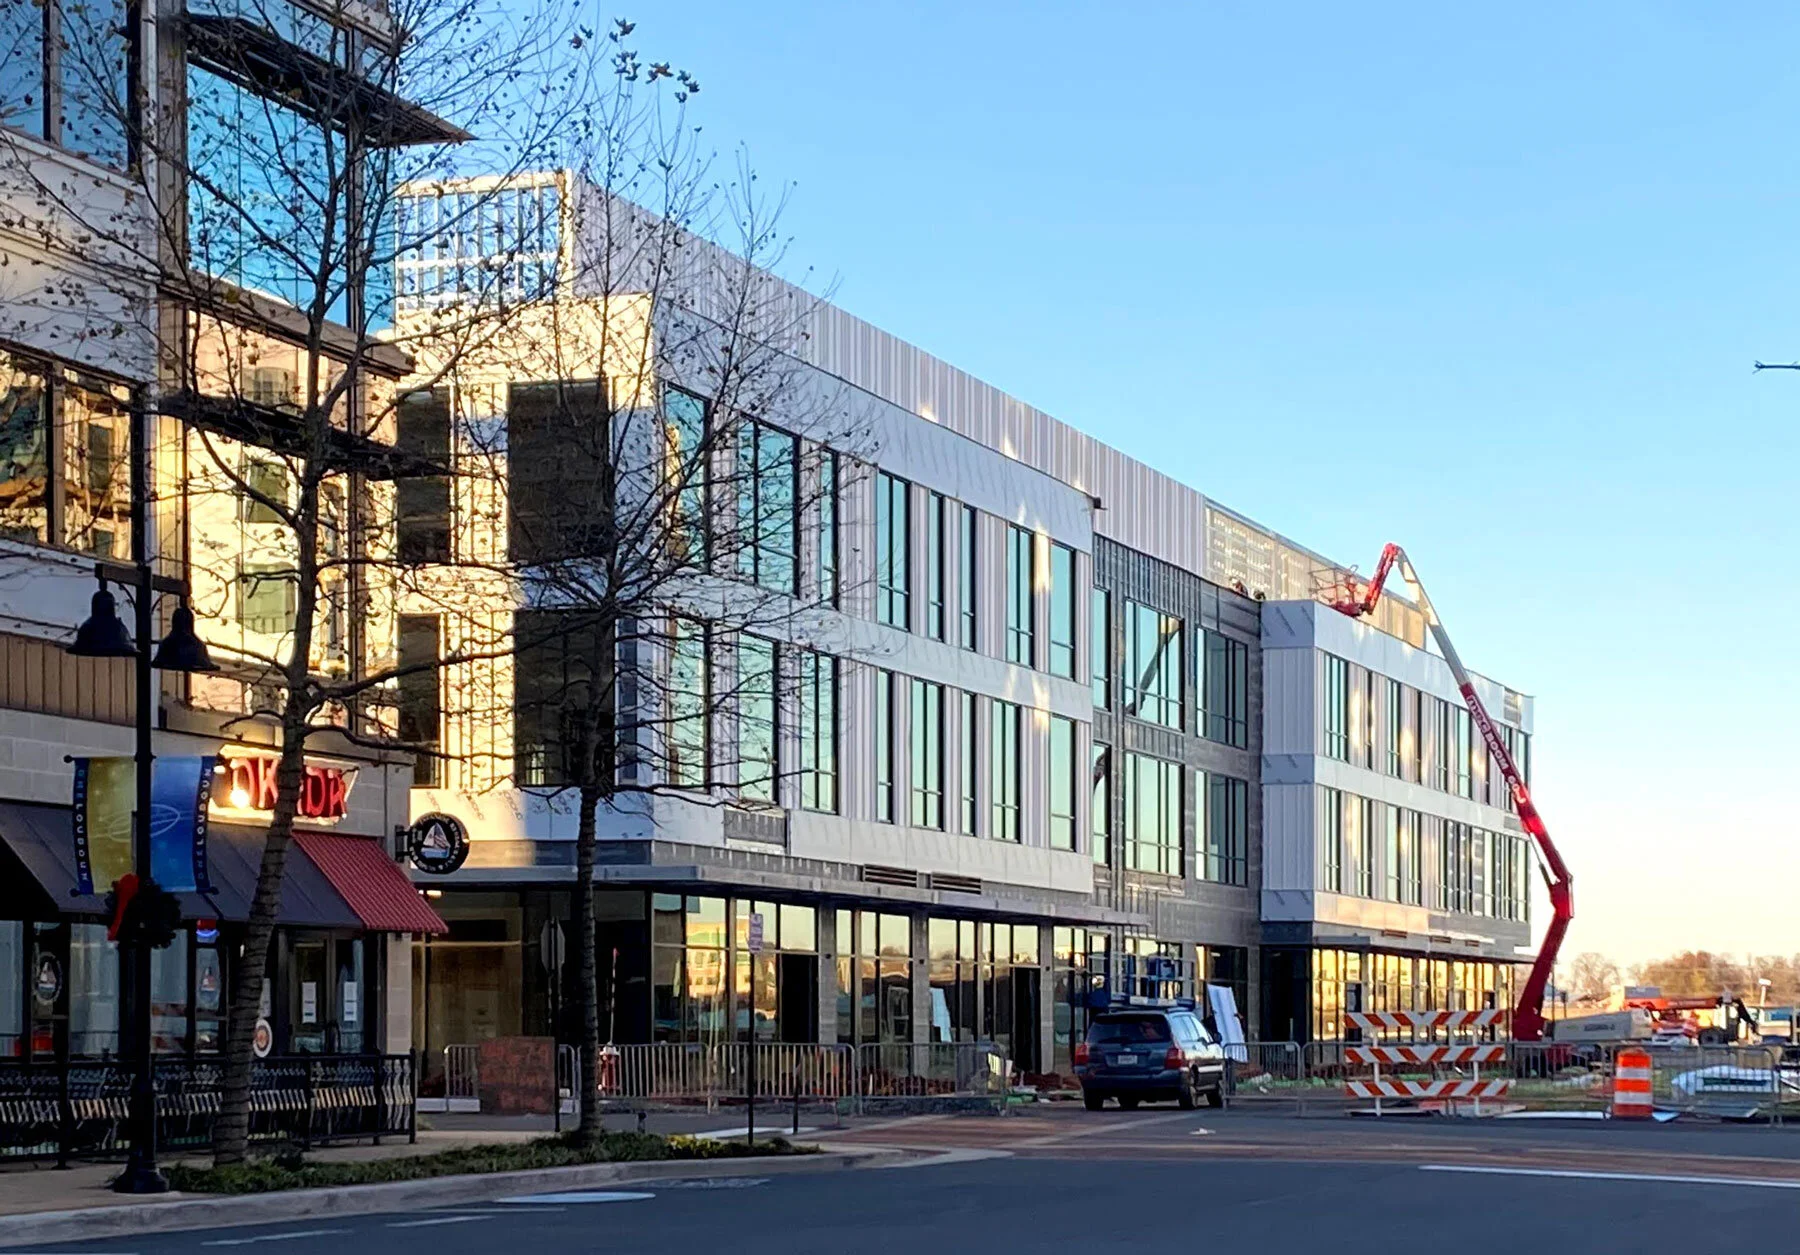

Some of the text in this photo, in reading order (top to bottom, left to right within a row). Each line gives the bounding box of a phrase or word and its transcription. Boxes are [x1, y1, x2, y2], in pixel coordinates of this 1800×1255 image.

[1484, 732, 1509, 770] BOOM
[75, 802, 88, 881] LOUDOUN
[195, 767, 212, 846] LOUDOUN
